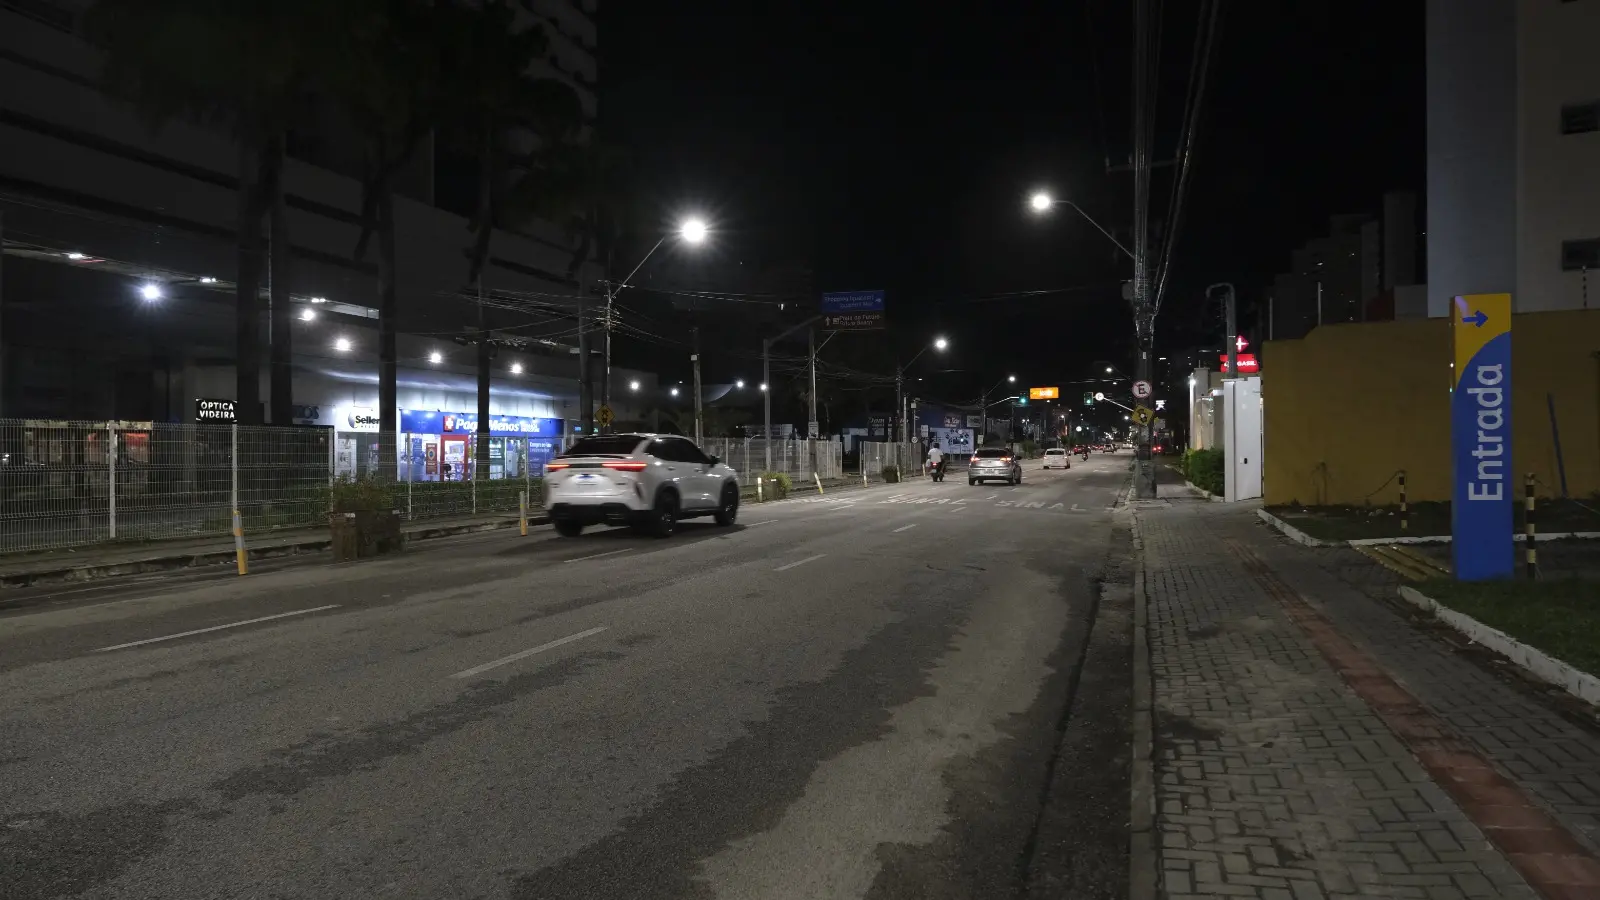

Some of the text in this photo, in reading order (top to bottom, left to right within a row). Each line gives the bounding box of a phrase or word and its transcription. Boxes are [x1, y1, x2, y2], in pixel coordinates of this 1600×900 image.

[488, 419, 520, 432] Menos
[1467, 364, 1504, 502] Entrada
[994, 500, 1087, 511] SINAL
